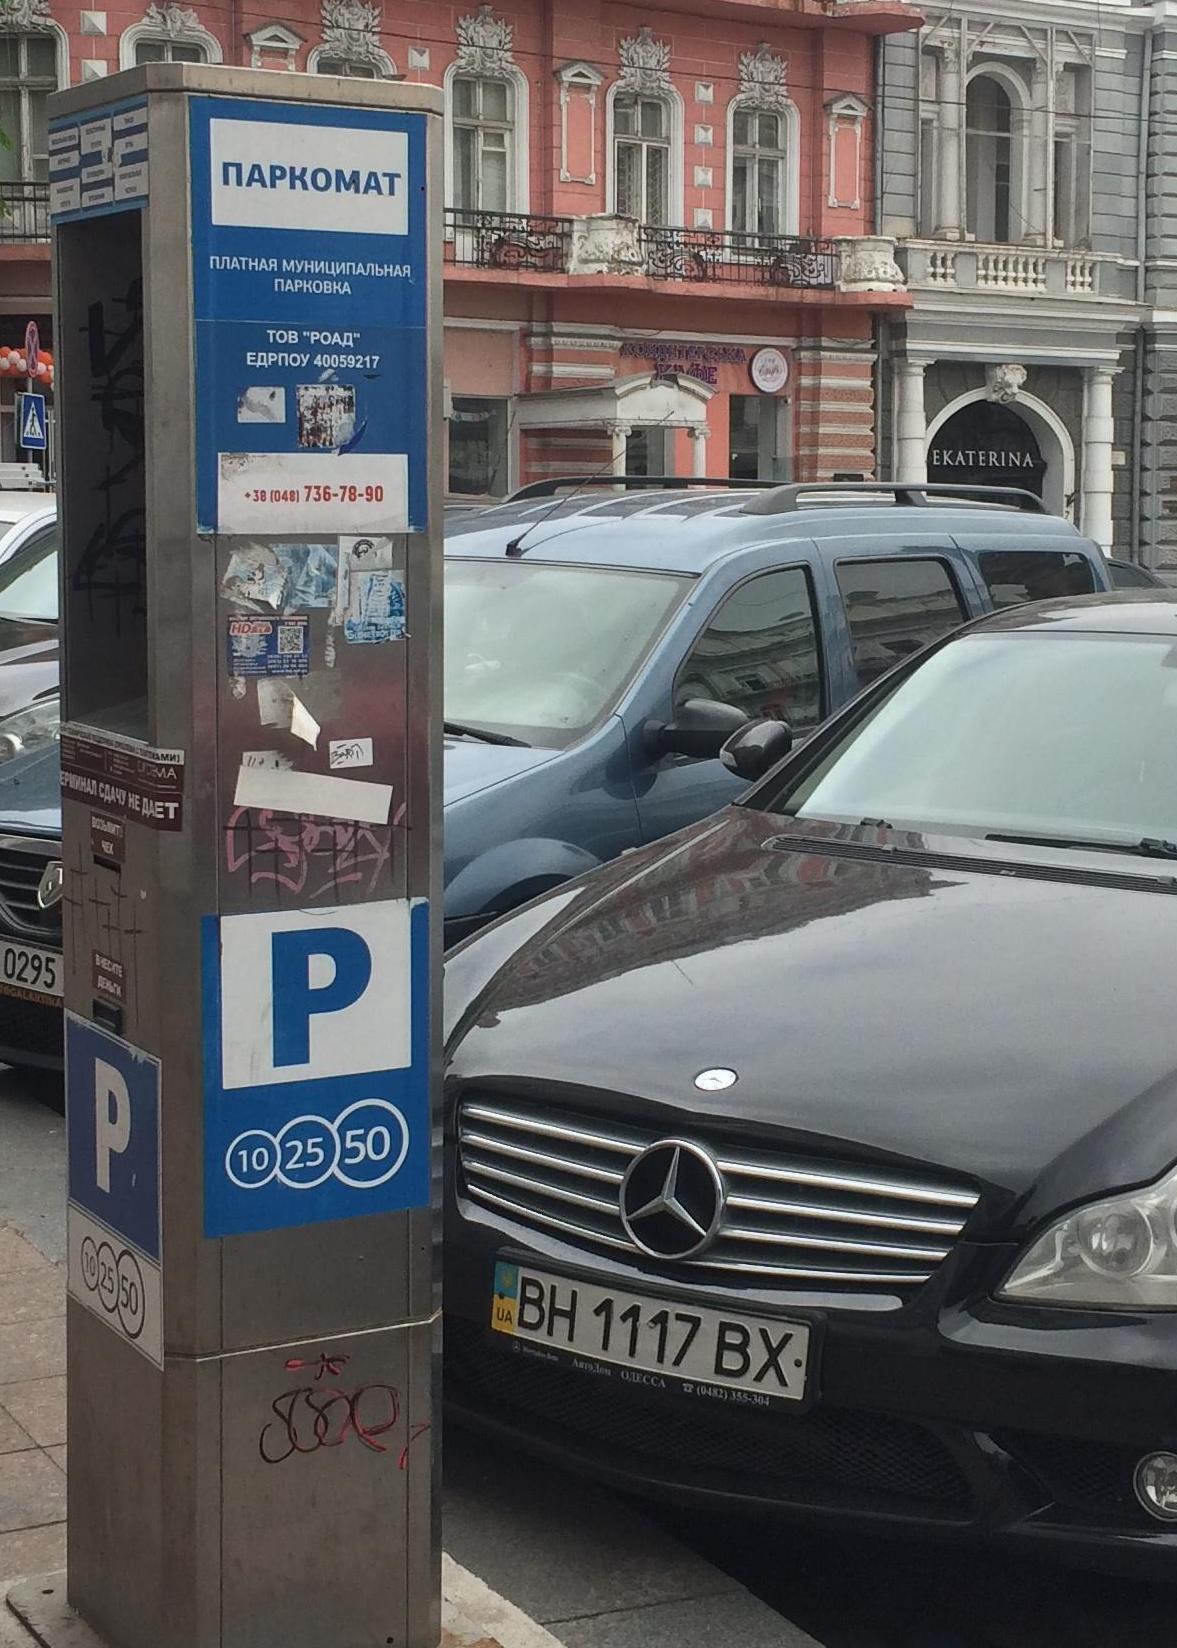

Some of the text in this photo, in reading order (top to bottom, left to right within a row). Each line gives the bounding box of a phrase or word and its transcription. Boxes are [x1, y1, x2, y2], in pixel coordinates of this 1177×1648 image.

[222, 161, 402, 196] ПАРКОМАТ
[209, 255, 411, 278] ПЛАТНАЯ МУНИЦИПАЛЬНАЯ
[274, 278, 352, 294] ПАРКОВКА
[267, 330, 360, 347] ТОВ "РОАД"
[246, 352, 380, 369] ЕДРПОУ 40059217
[932, 450, 1034, 468] EKATERINA
[270, 489, 300, 504] (048)
[304, 485, 384, 502] 736-78-90
[60, 771, 179, 820] ЕРМИНАЛ СДАЧУ НЕ ДАЕТ
[4, 948, 56, 989] 0295
[272, 926, 373, 1068] P
[95, 1057, 131, 1193] P
[238, 1125, 391, 1173] 10 25 50
[84, 1250, 138, 1316] 10 25 50
[496, 1306, 513, 1326] UA
[517, 1276, 794, 1388] BH 1117 BX
[620, 1370, 667, 1389] ОДЕССА
[696, 1385, 729, 1401] (0482)
[730, 1388, 770, 1407] 355-304
